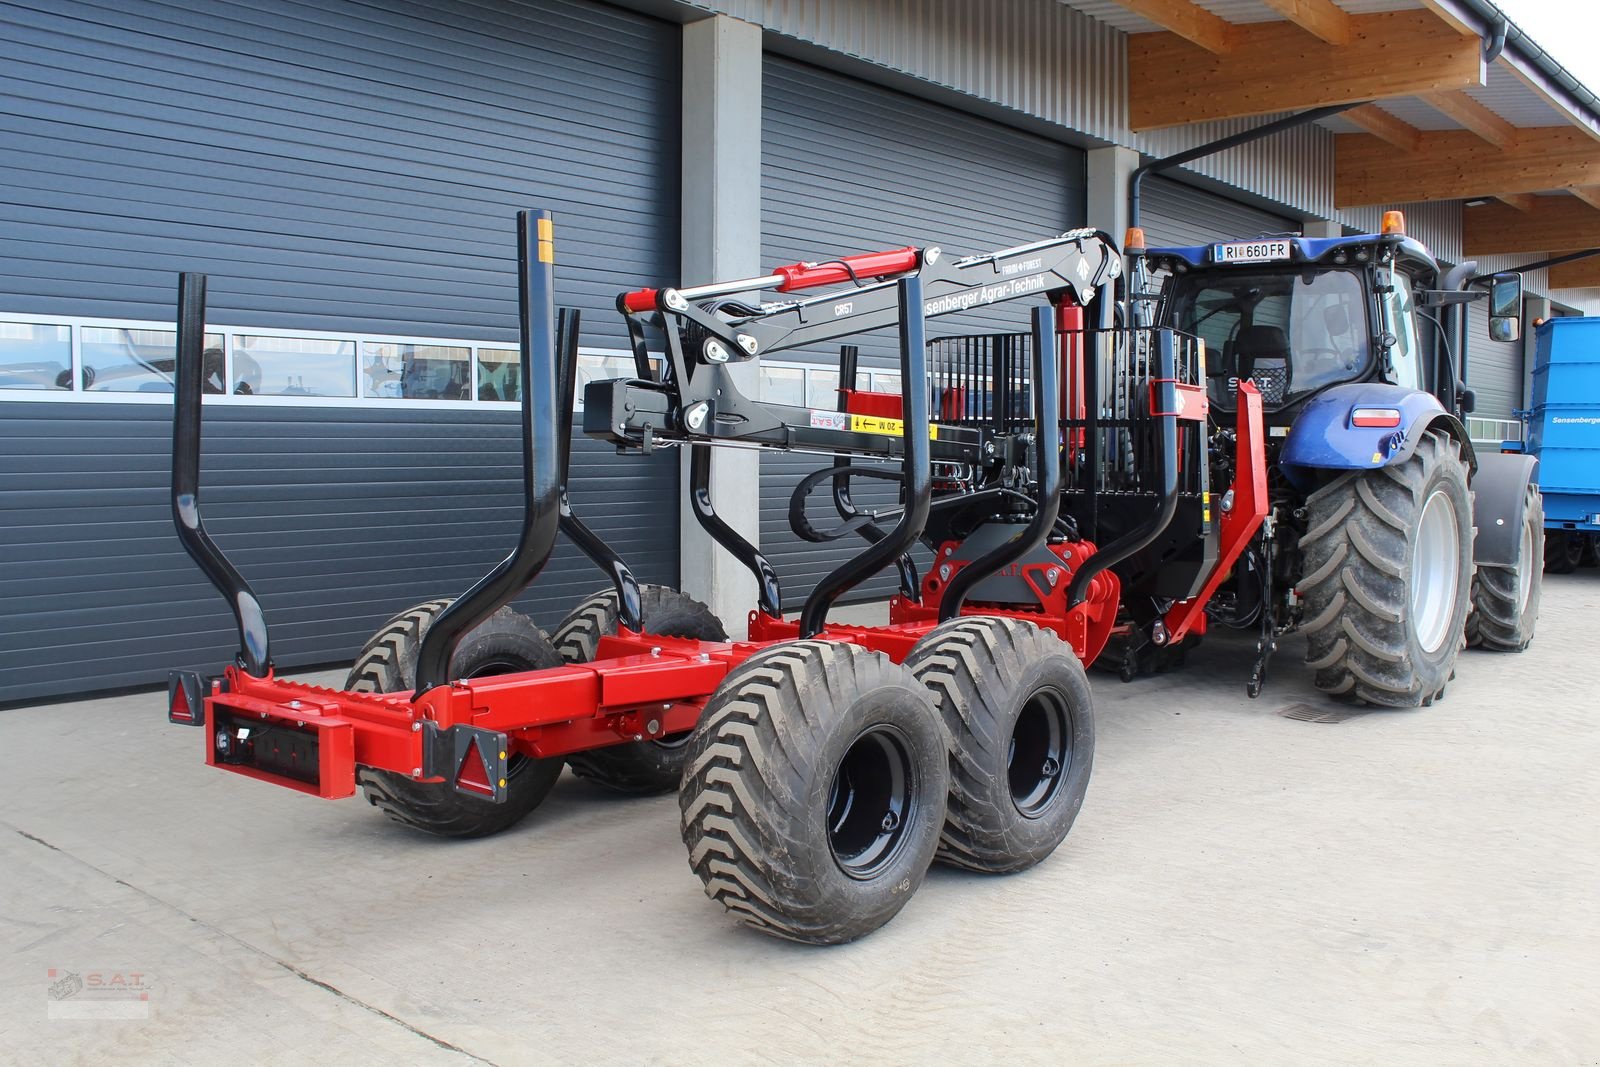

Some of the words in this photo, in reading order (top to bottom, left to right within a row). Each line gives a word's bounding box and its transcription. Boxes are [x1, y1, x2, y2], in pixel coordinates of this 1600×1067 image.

[1226, 246, 1238, 258] RI
[1246, 245, 1268, 258] 660
[1270, 243, 1284, 256] FR
[1023, 257, 1042, 272] FOREST
[980, 274, 1046, 306] Agrar-Technik
[887, 422, 896, 431] 20
